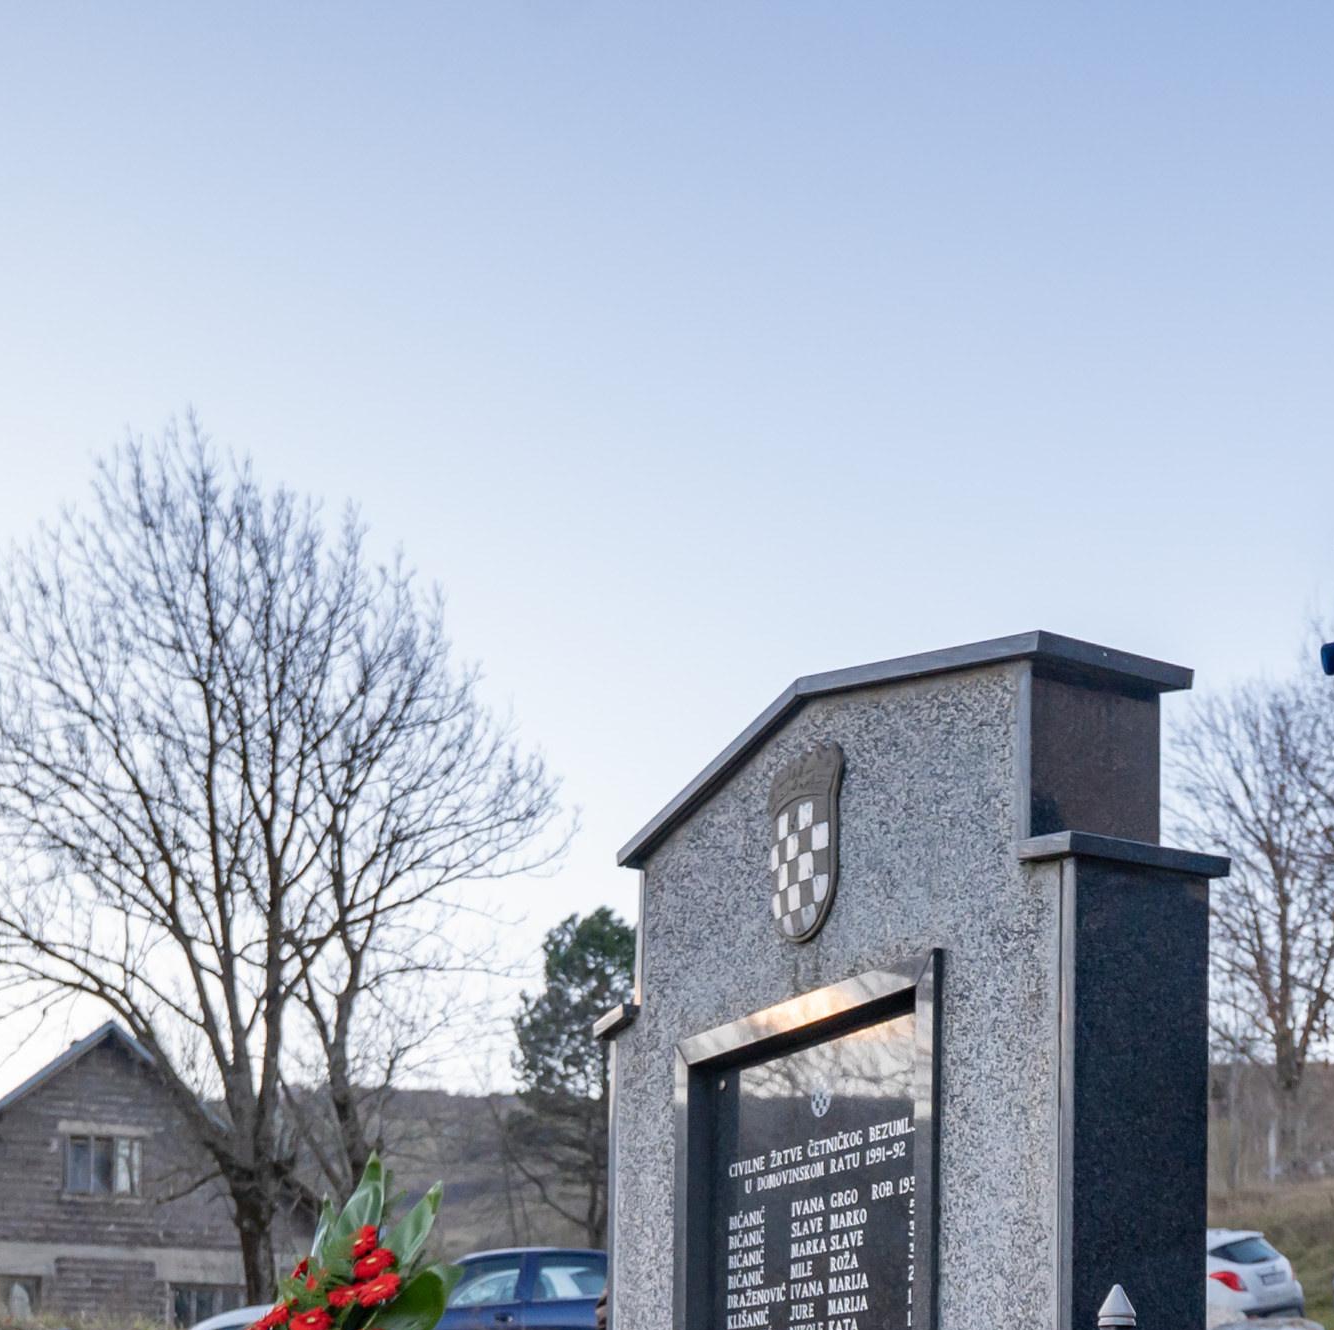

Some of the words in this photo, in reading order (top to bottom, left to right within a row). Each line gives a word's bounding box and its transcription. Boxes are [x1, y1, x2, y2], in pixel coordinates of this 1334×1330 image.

[729, 1156, 765, 1177] CIVILNE
[770, 1146, 803, 1168] ŽRTVE
[808, 1130, 863, 1157] ČETNIČKOG
[869, 1117, 915, 1142] BEZUML
[745, 1181, 752, 1193] U
[757, 1161, 824, 1191] DOMOVINSKOM
[830, 1152, 860, 1174] RATU
[866, 1142, 905, 1165] 1991-92
[792, 1197, 825, 1217] IVANA
[831, 1189, 858, 1208] GRGO
[791, 1217, 822, 1237] SLAVE
[830, 1208, 867, 1230] MARKO
[791, 1238, 827, 1259] MARKA
[830, 1231, 863, 1250] SLAVE
[790, 1261, 812, 1279] MILE
[830, 1252, 858, 1272] ROŽA
[727, 1282, 786, 1309] DRAŽENOVIĆ
[790, 1281, 824, 1299] IVANA
[829, 1273, 868, 1293] MARIJA
[727, 1306, 769, 1330] KLIŠANIĆ
[790, 1303, 814, 1321] JURE
[828, 1295, 868, 1316] MARIJA
